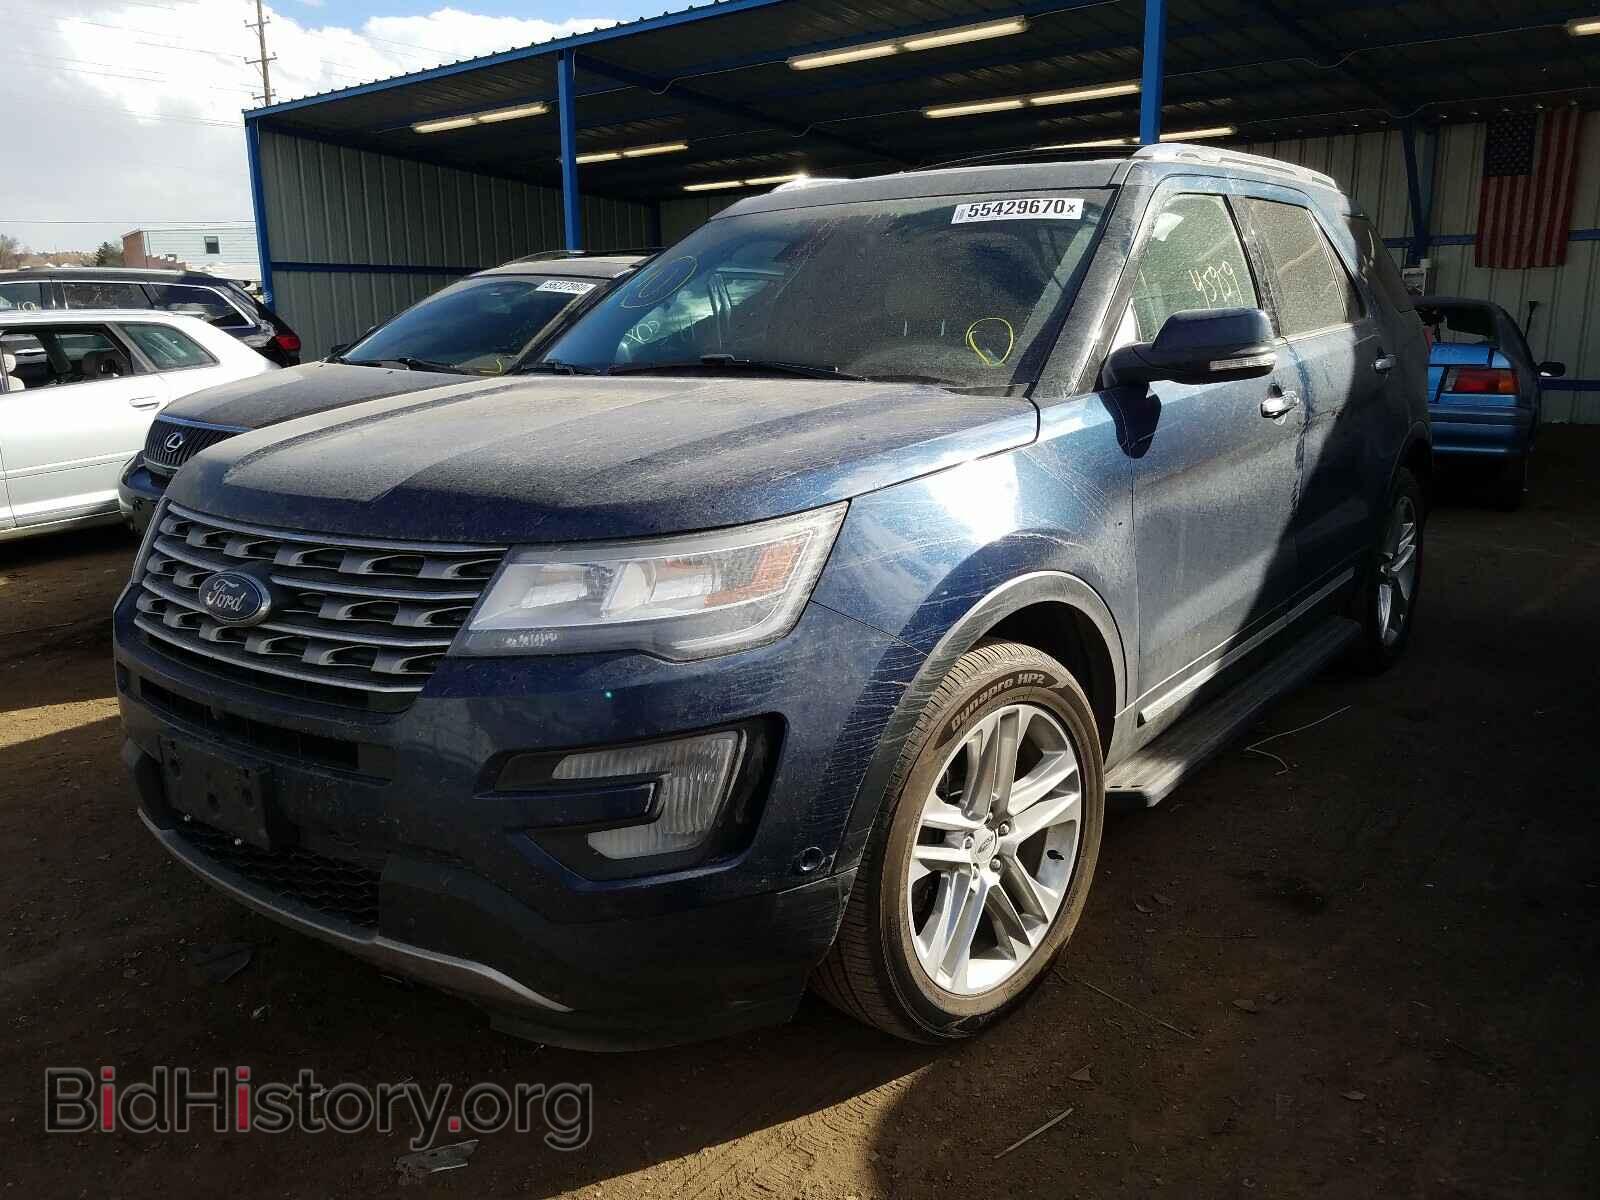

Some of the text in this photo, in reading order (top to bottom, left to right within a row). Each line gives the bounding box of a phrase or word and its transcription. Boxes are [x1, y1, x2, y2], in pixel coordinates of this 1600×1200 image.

[206, 578, 247, 612] Ford
[951, 672, 1046, 733] Dynapro HP2
